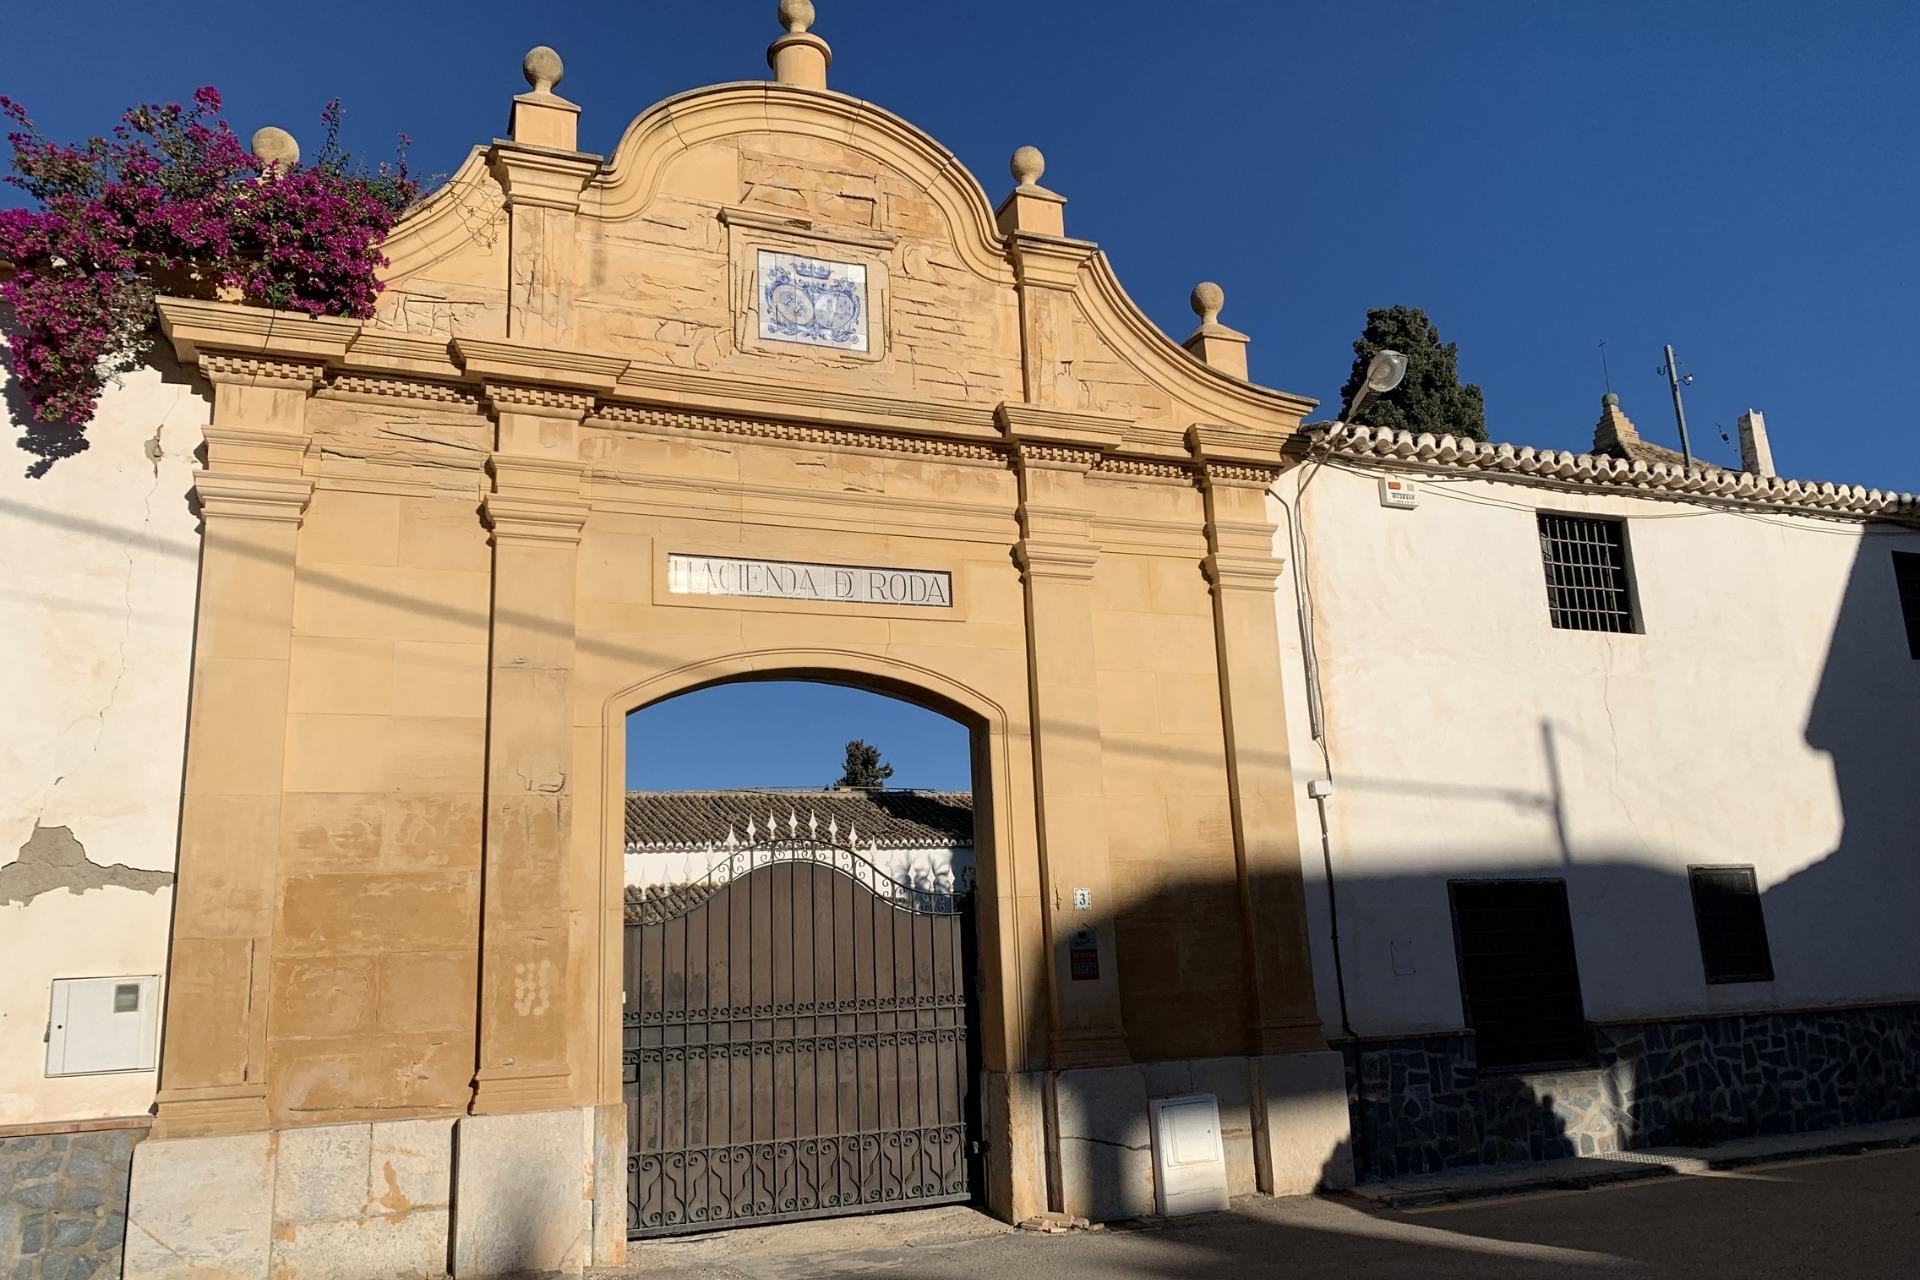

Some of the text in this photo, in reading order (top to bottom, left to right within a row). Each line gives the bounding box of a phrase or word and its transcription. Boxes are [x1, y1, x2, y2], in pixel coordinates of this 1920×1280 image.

[673, 560, 819, 597] HACIENDA
[869, 572, 946, 603] RODA
[1079, 893, 1086, 905] 3
